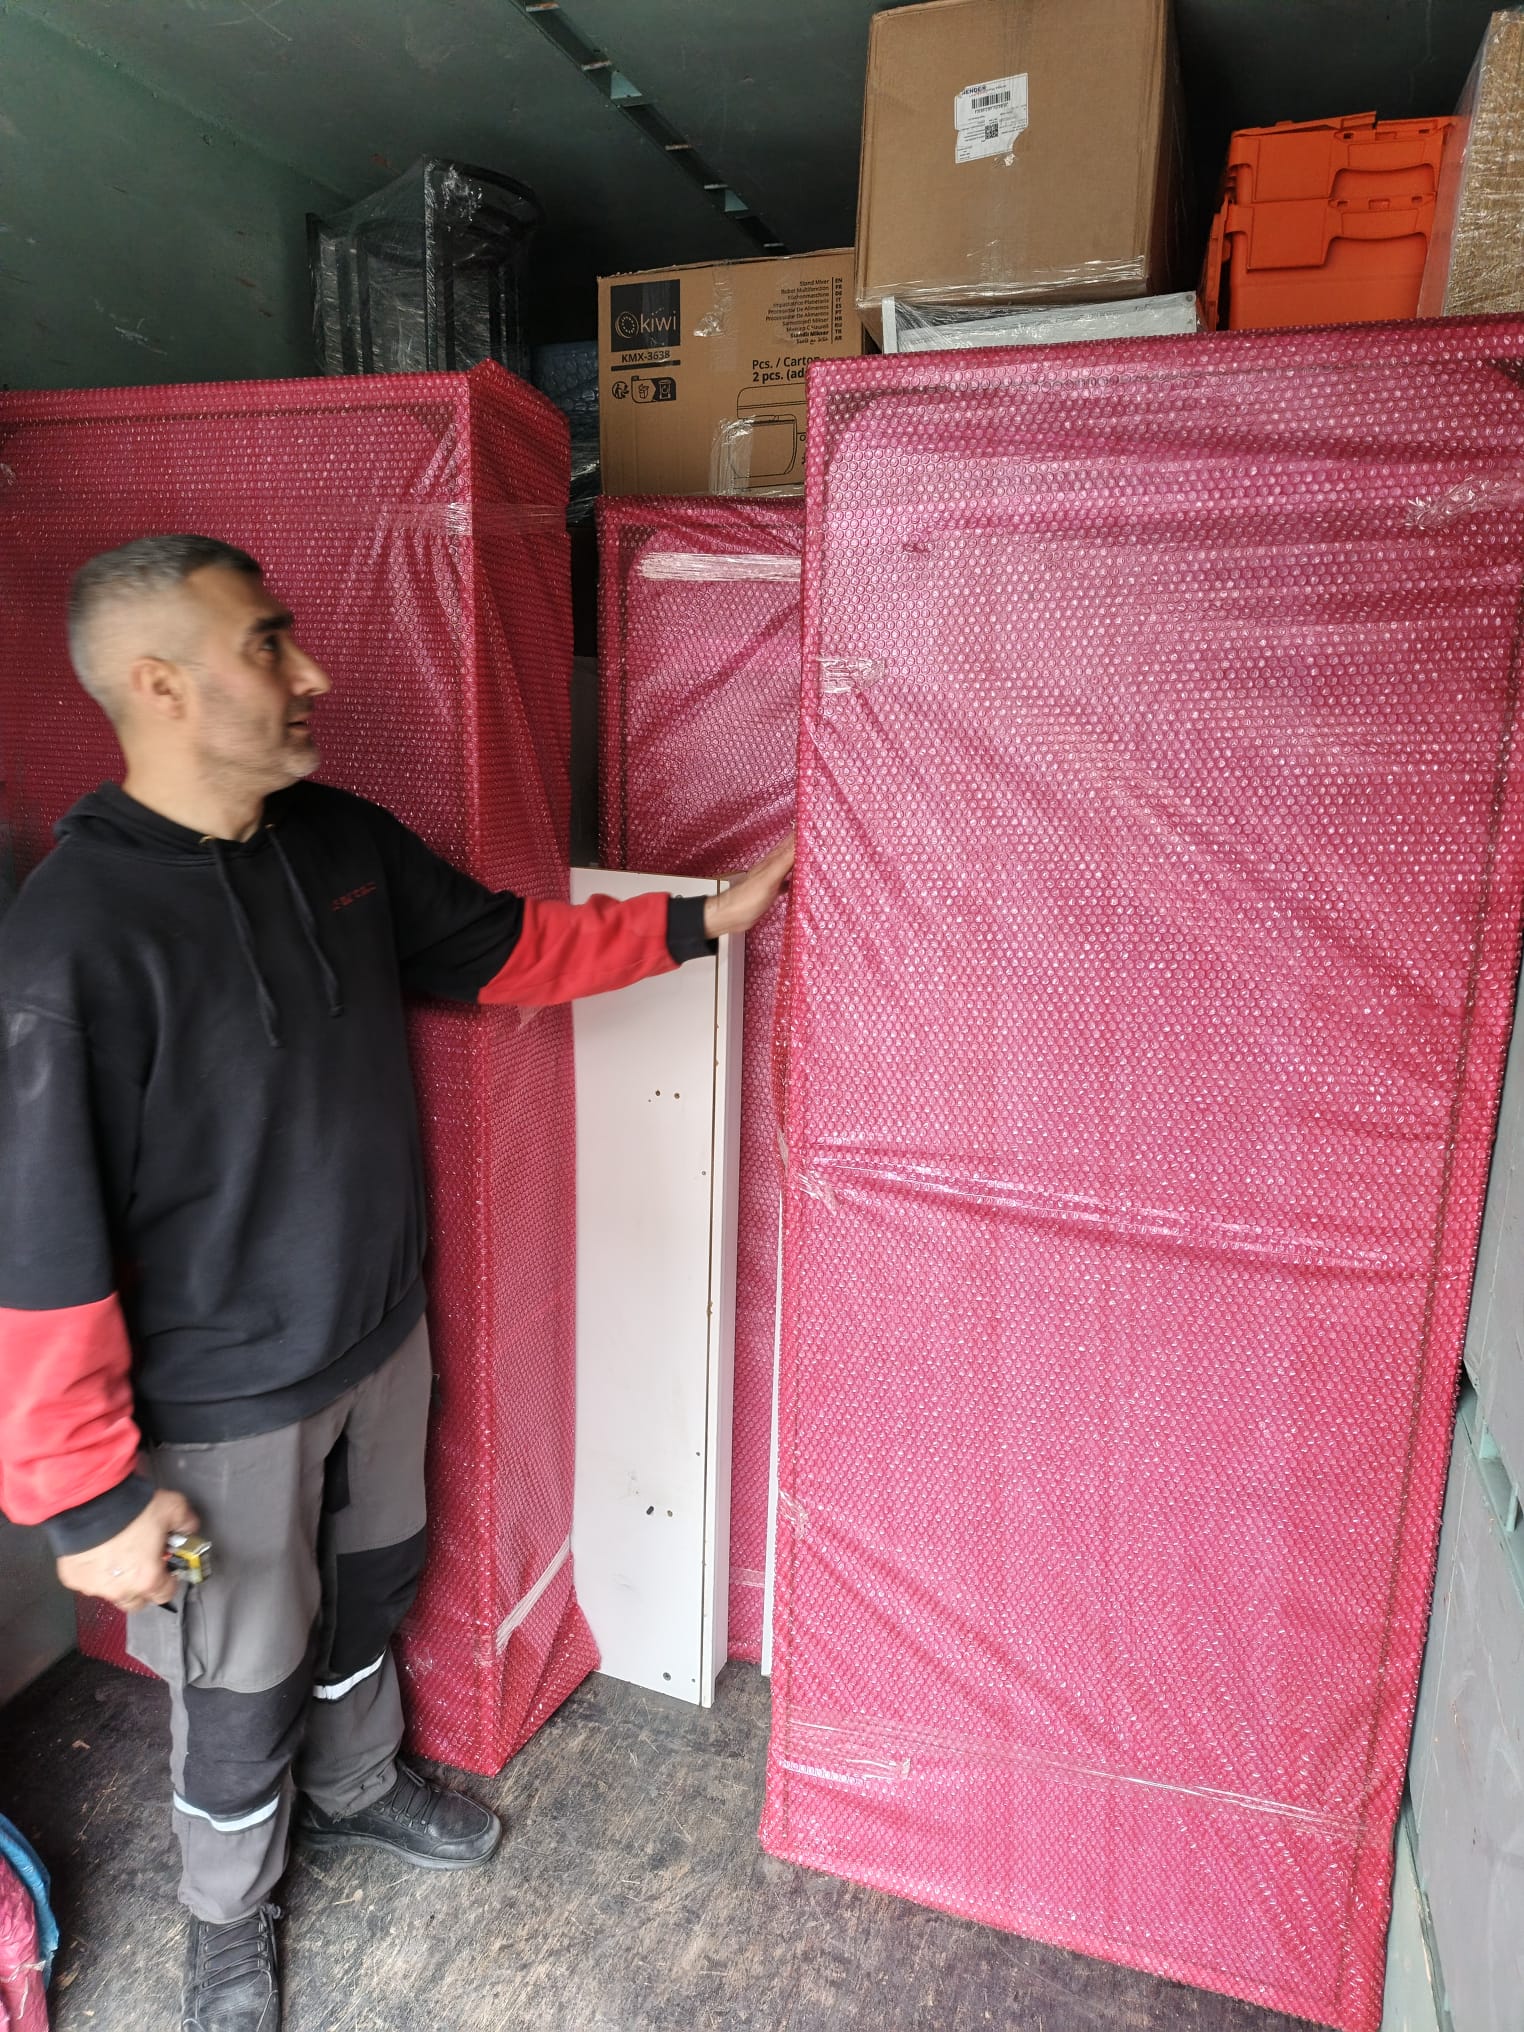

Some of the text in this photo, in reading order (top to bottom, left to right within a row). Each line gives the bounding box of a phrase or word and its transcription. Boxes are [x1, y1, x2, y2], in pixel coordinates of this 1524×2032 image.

[640, 310, 676, 333] kiwi
[621, 350, 671, 363] KMX-3638
[752, 356, 820, 370] Pcs. / Carto
[752, 367, 806, 384] 2 pcs. (ad
